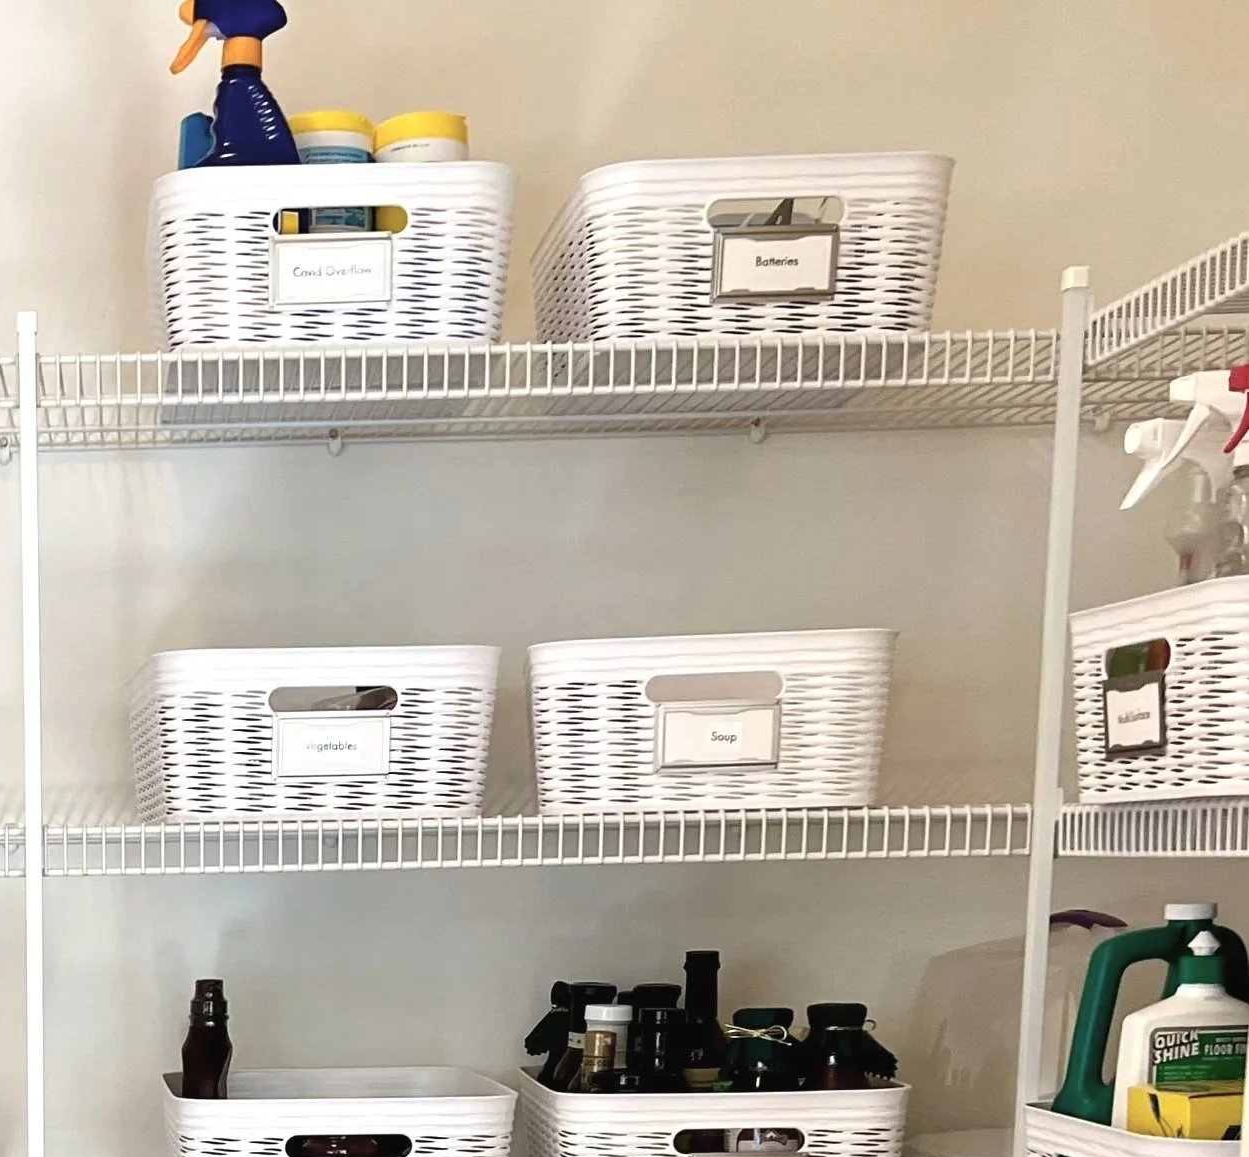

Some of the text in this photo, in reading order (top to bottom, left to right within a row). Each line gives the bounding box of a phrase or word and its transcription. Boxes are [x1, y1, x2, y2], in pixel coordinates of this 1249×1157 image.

[755, 256, 799, 267] Batteries
[292, 266, 322, 277] Covid
[710, 731, 737, 744] Soup
[1154, 1029, 1199, 1049] QUICK
[1154, 1042, 1199, 1064] SHINE
[1204, 1044, 1233, 1056] FLOOR
